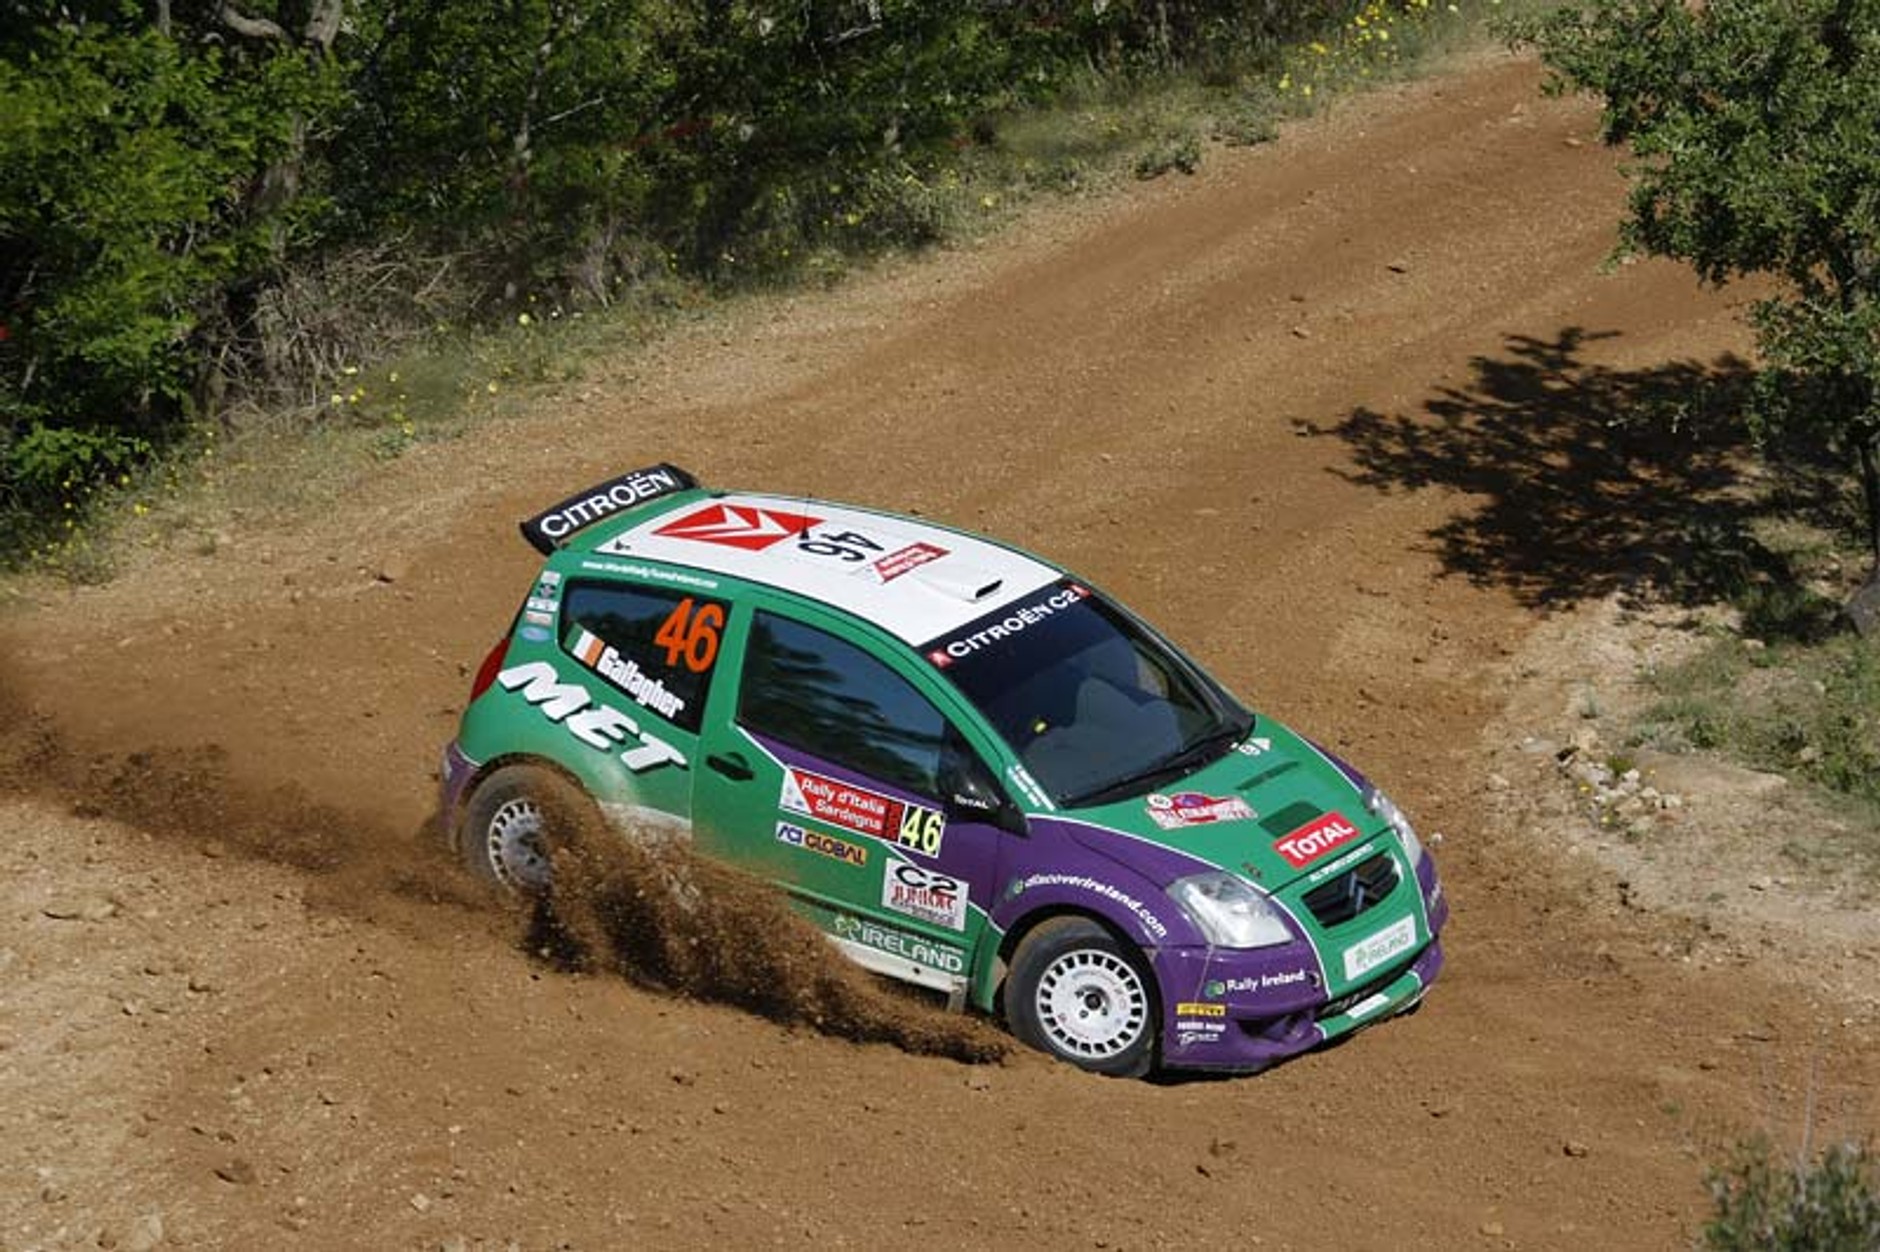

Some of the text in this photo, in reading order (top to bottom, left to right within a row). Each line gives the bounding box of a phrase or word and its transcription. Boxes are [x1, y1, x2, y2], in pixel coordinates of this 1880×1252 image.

[540, 470, 674, 537] CITROËN
[799, 532, 885, 561] 46
[654, 596, 724, 673] 46
[946, 587, 1082, 658] CITROËN C2
[596, 645, 685, 719] Gallagher
[497, 661, 689, 771] MET
[801, 778, 886, 815] Rally d'Italia
[815, 799, 883, 831] Sardegna
[804, 833, 866, 866] GLOBAL
[901, 806, 942, 853] 46
[1278, 821, 1355, 861] TOTAL
[895, 866, 958, 901] C2
[1024, 874, 1168, 938] discoverireland.com
[861, 926, 964, 974] IRELAND
[1226, 968, 1306, 995] Rally Ireland
